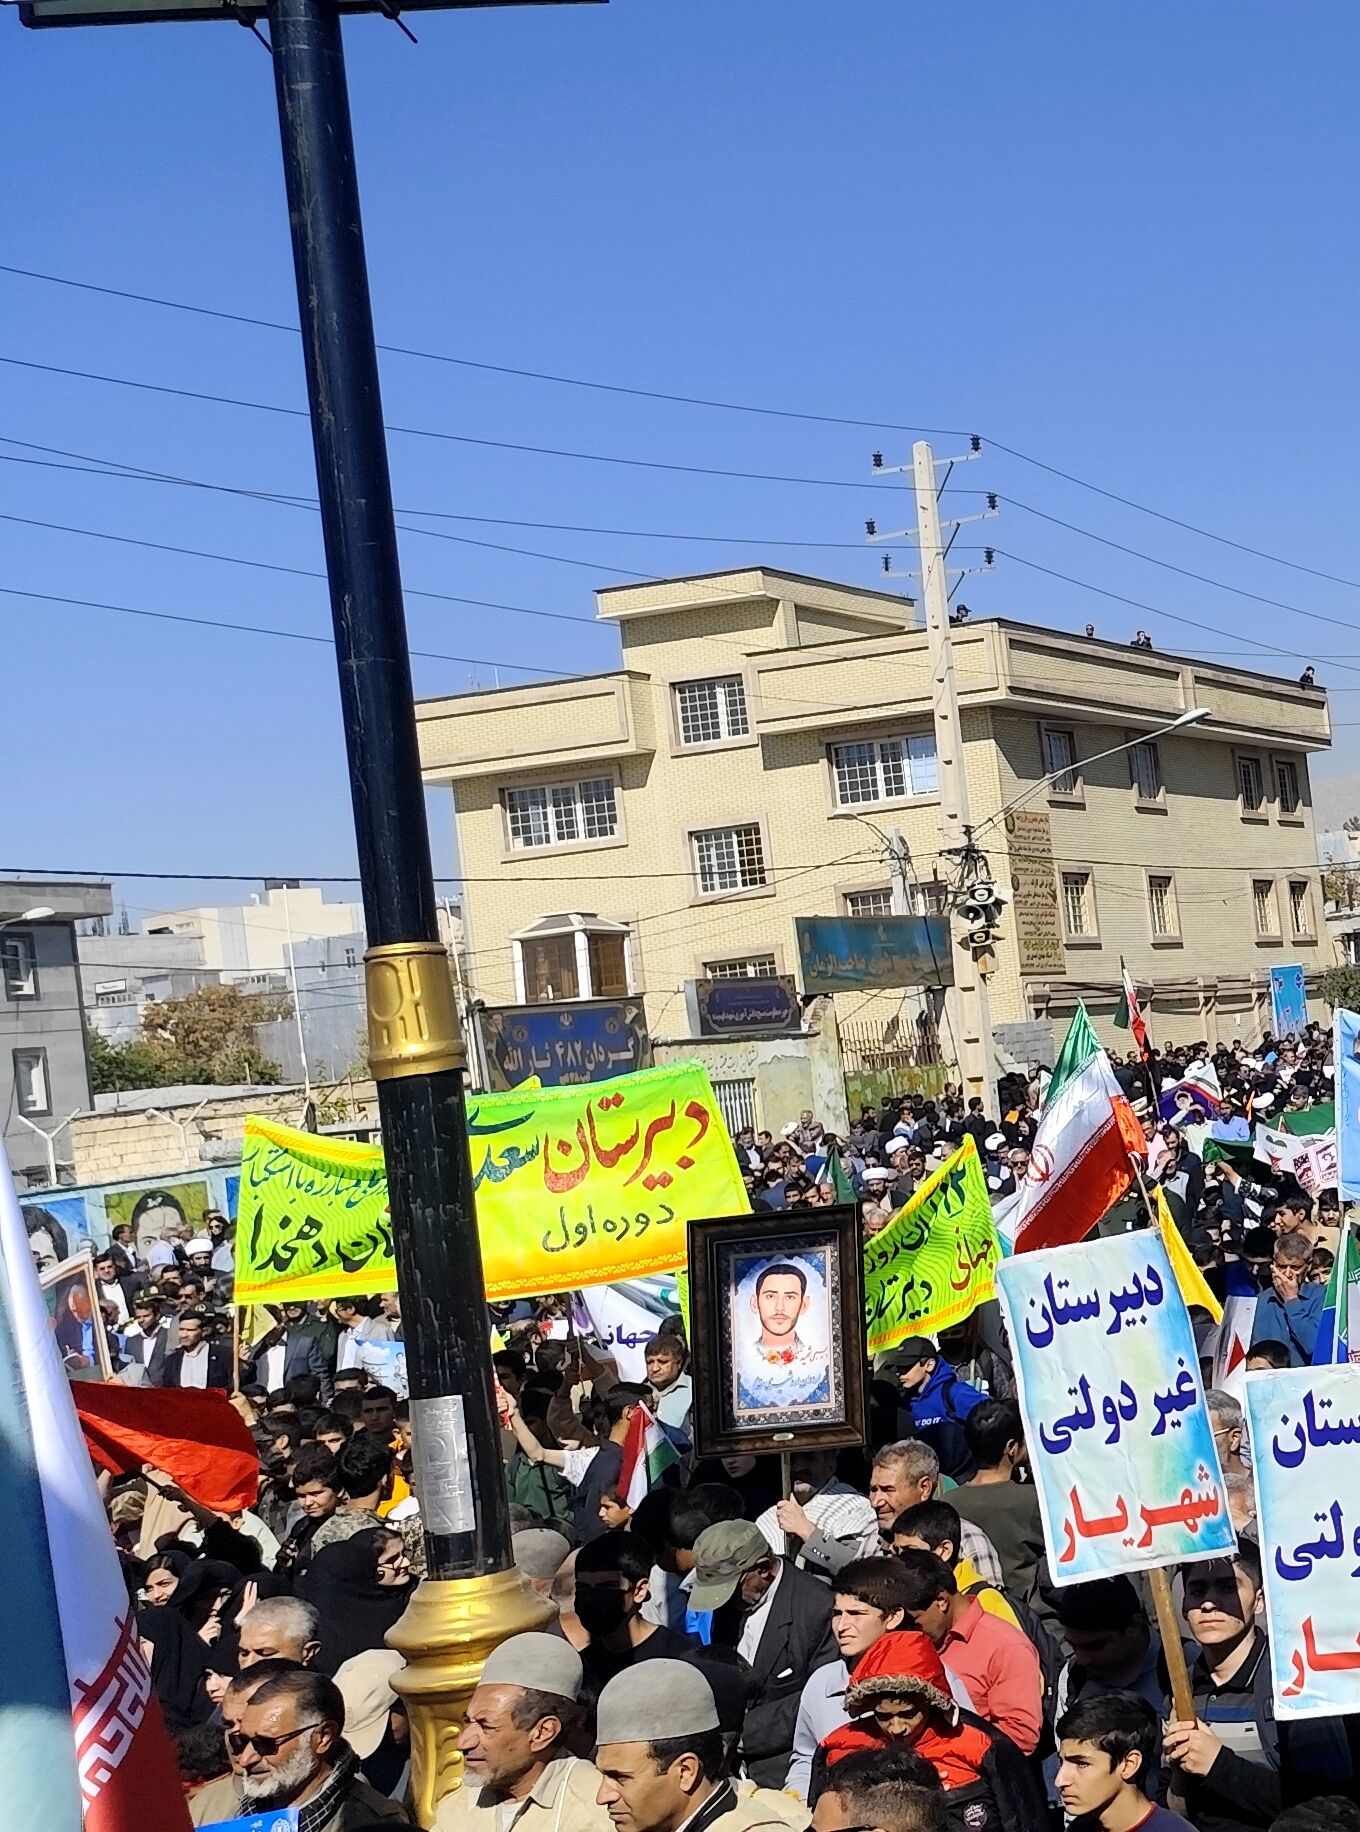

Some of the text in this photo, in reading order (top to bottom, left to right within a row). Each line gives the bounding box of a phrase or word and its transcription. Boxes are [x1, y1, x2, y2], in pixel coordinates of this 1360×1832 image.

[503, 1037, 634, 1077] گردان ۴۸۲ ثار الله
[543, 1092, 710, 1194] دبیرستان
[249, 1203, 329, 1273] دهخدا
[541, 1203, 675, 1253] دوره اول
[950, 1226, 994, 1292] جهانی
[1025, 1262, 1165, 1349] دبیرستان
[1038, 1356, 1198, 1456] غیر دولتی
[1058, 1463, 1221, 1563] شهریار
